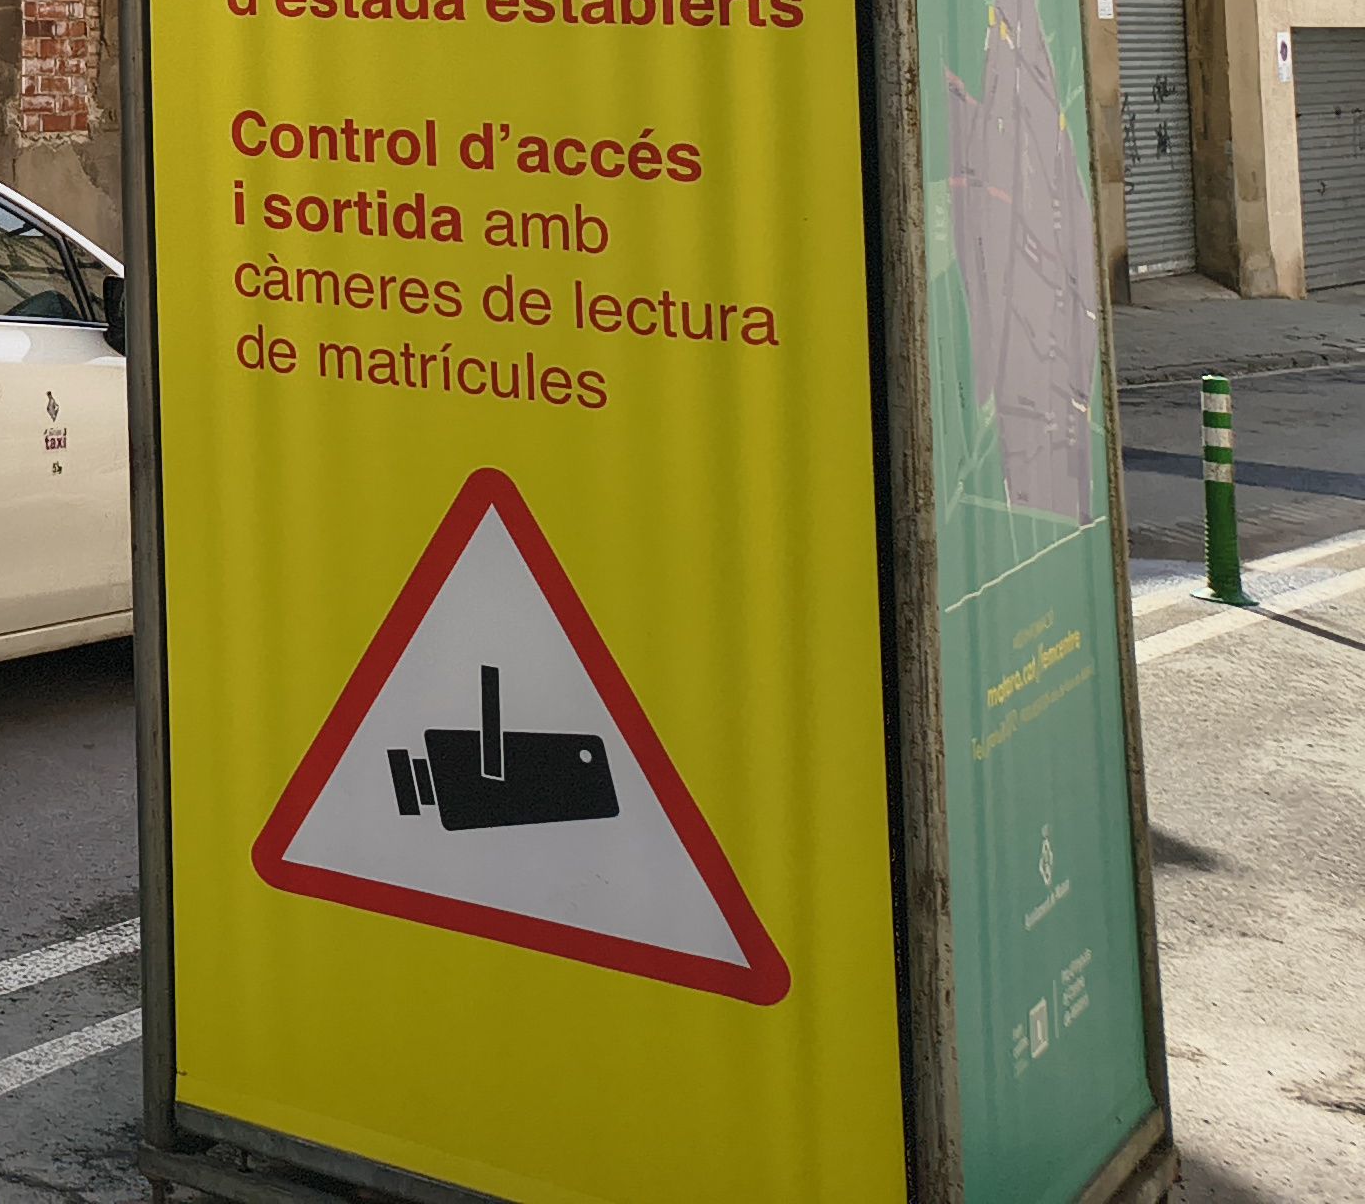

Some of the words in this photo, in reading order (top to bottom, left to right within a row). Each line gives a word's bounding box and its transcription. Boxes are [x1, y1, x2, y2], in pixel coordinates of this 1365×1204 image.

[231, 109, 437, 167] Control
[458, 122, 702, 183] d’accés
[233, 180, 245, 225] i
[263, 188, 463, 243] sortida
[484, 203, 609, 254] amb
[234, 252, 463, 319] càmeres
[482, 274, 552, 326] de
[575, 281, 779, 346] lectura
[236, 324, 297, 374] de
[318, 340, 608, 409] matrícules
[44, 435, 67, 450] taxi
